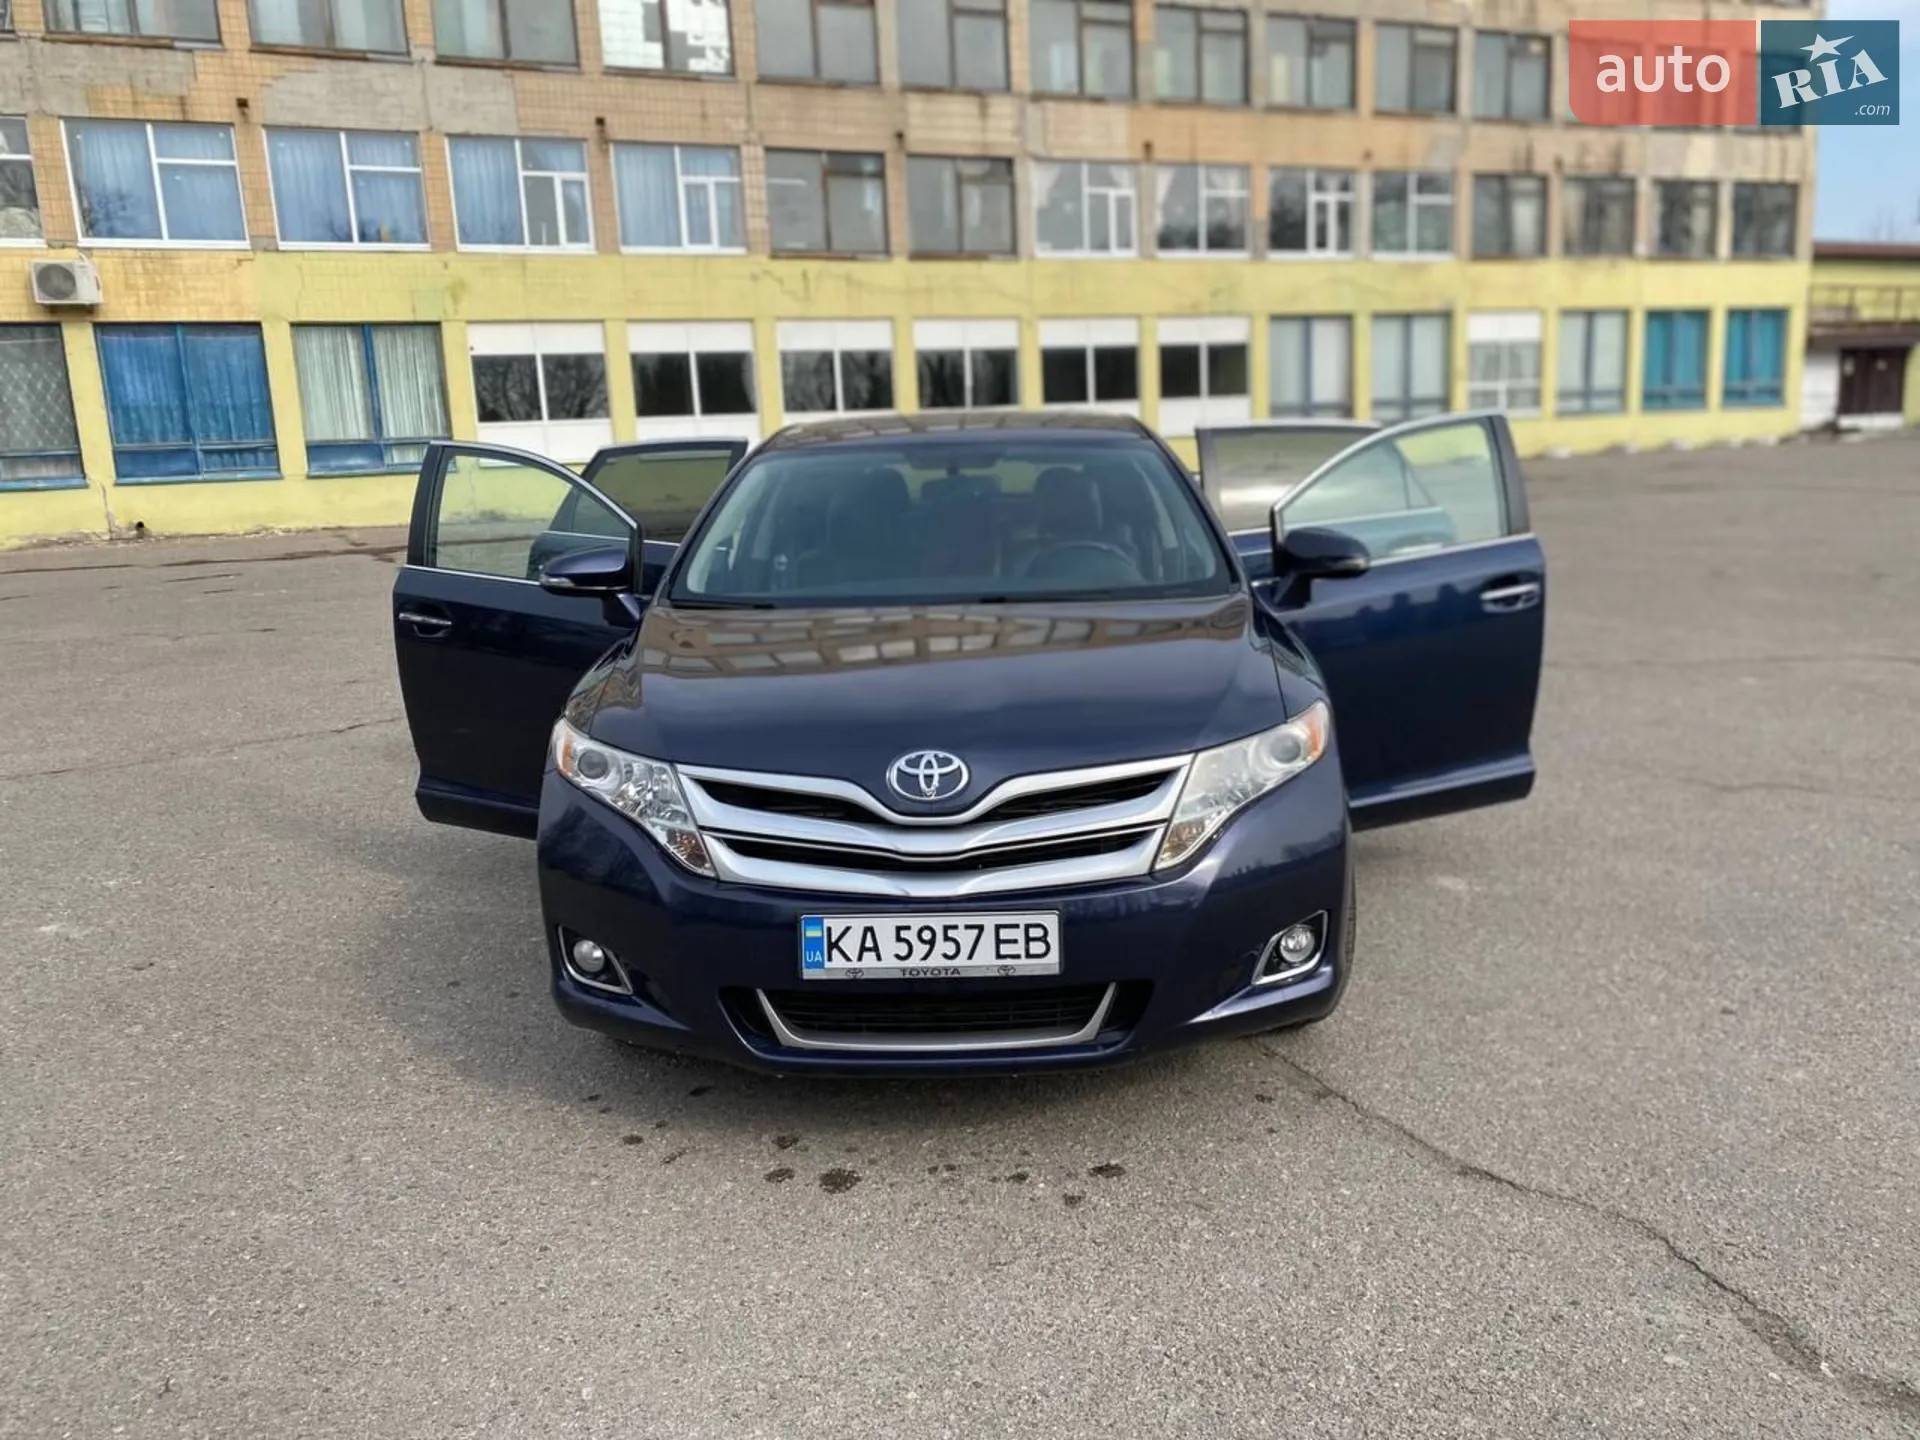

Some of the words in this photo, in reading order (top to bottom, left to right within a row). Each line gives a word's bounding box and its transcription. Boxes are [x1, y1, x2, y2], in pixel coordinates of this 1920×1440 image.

[826, 925, 882, 962] KA
[893, 924, 985, 961] 5957
[994, 923, 1051, 960] EB
[805, 951, 822, 963] UA
[901, 967, 961, 977] TOYOTA
